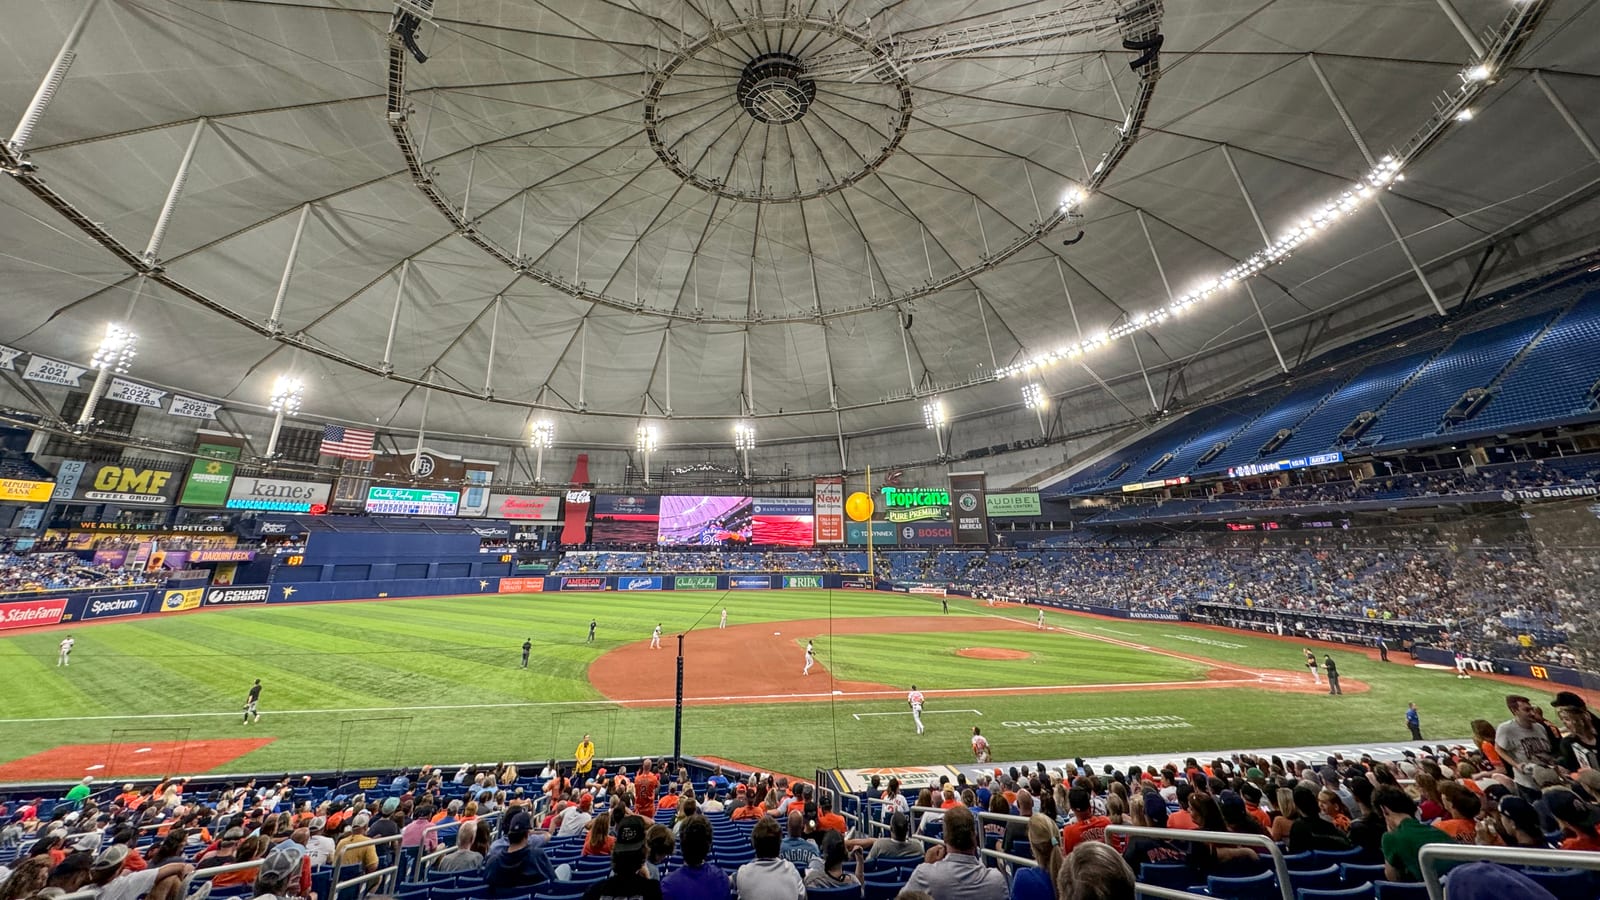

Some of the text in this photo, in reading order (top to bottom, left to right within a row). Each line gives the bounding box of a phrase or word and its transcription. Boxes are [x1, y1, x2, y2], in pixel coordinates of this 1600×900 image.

[40, 365, 68, 377] 2021
[28, 372, 75, 385] CHAMPIONS
[113, 392, 155, 406] WILD CARD
[122, 387, 151, 399] 2022
[182, 403, 207, 413] 2023
[65, 463, 80, 473] 42
[2, 481, 40, 490] REPUBLIC
[61, 475, 73, 485] 12
[94, 466, 172, 494] GMF
[55, 487, 70, 497] 66
[881, 487, 949, 508] Tropicana
[1517, 486, 1597, 498] The Baldwin
[817, 494, 841, 503] New
[890, 508, 942, 520] PURE PREMIUM
[918, 529, 952, 538] BOSCH
[232, 551, 250, 561] DECK
[798, 578, 817, 587] RIPA
[91, 599, 136, 614] Spectrum
[1530, 665, 1548, 678] 137
